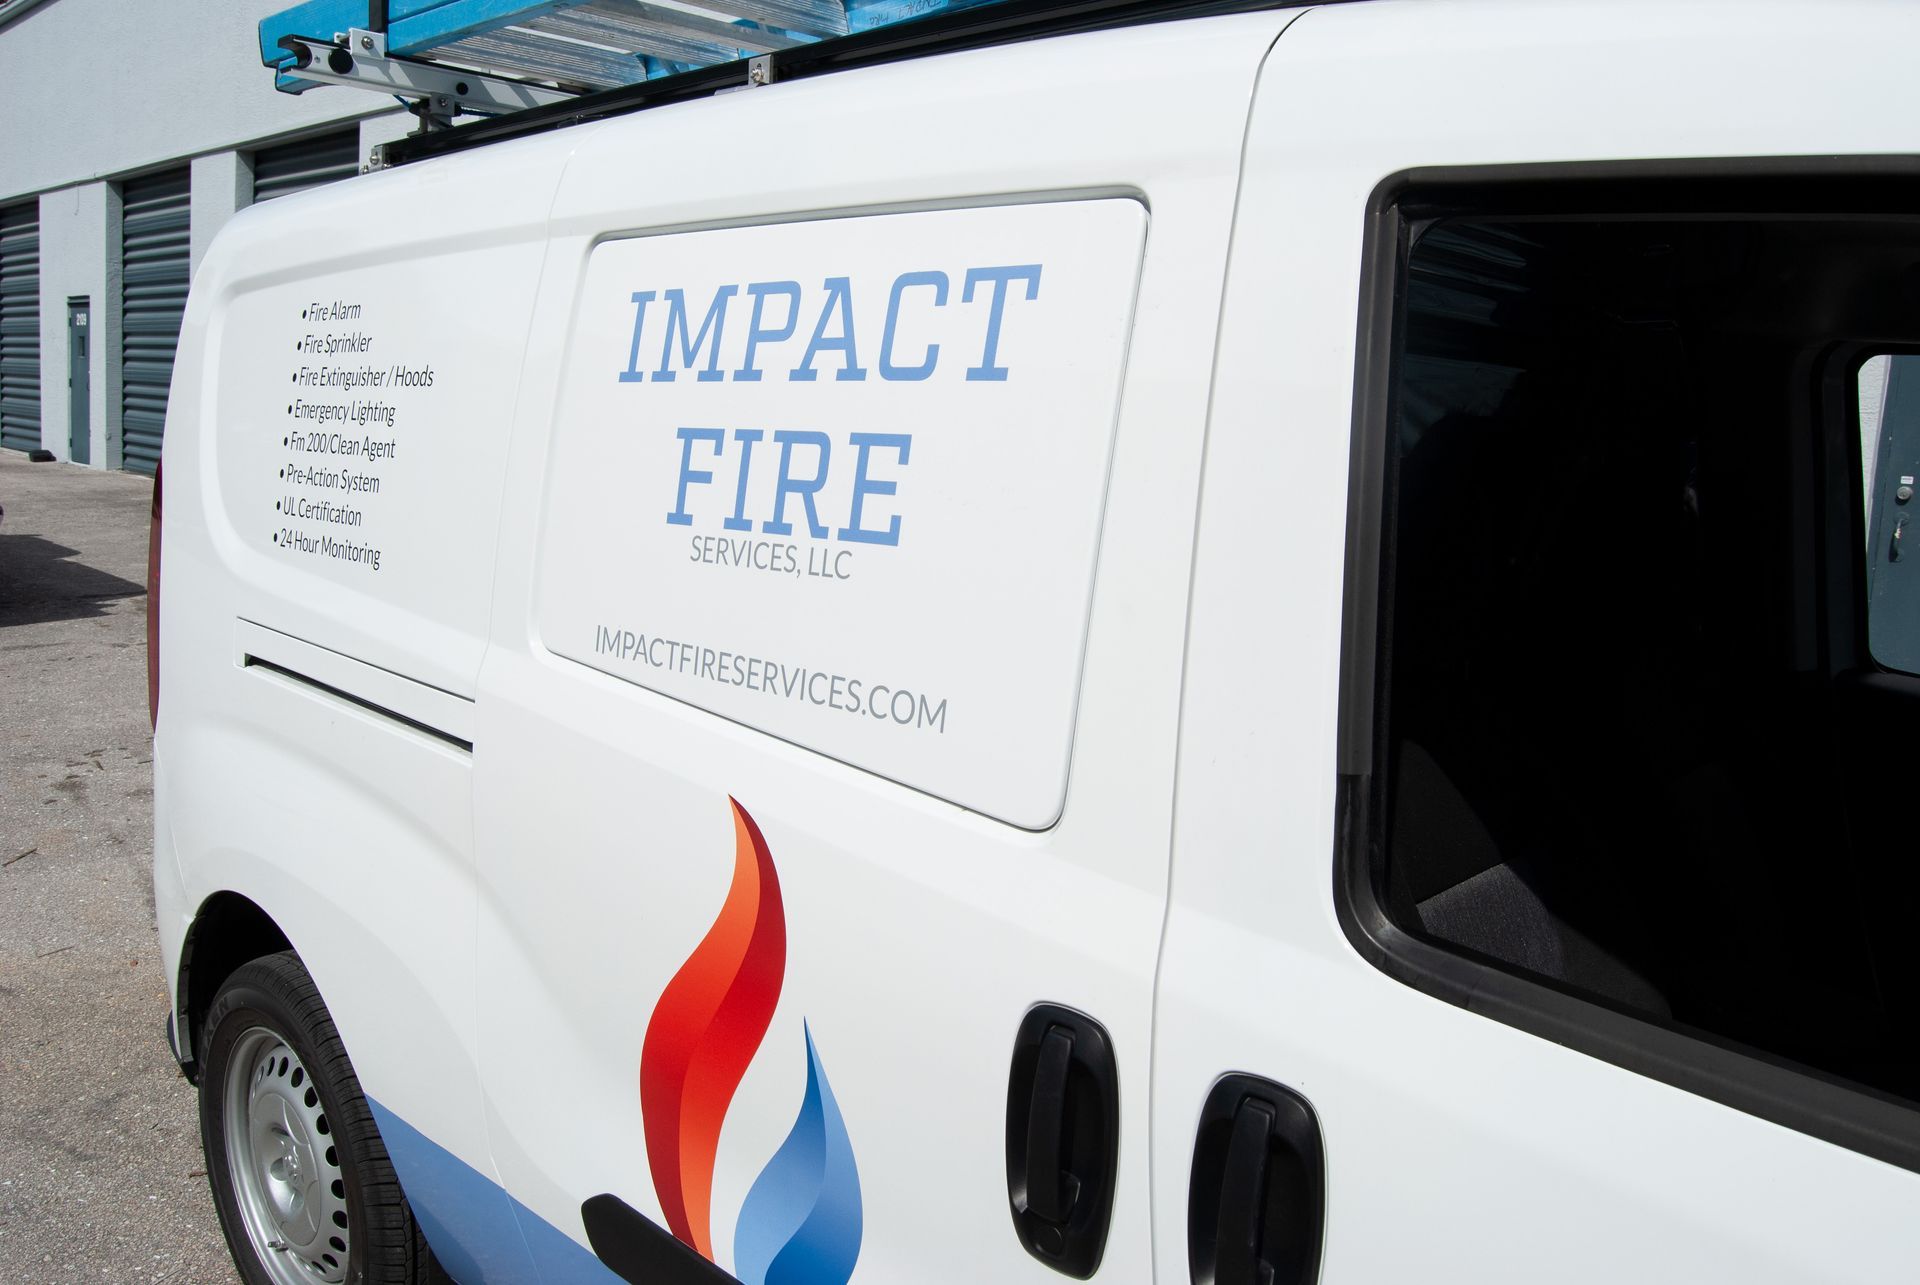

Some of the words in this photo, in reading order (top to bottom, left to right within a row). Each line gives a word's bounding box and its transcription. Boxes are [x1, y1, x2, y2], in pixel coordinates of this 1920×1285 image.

[308, 302, 329, 322] Fire
[329, 300, 362, 321] Alarm
[619, 264, 1042, 383] IMPACT
[303, 333, 324, 354] Fire
[324, 332, 373, 358] Sprinkler
[298, 366, 319, 387] Fire
[319, 365, 386, 392] Extinguisher
[394, 364, 435, 388] Hoods
[294, 398, 351, 425] Emergency
[351, 400, 397, 428] Lighting
[289, 431, 306, 452] Fm
[306, 432, 360, 457] 200/Clean
[360, 435, 397, 462] Agent
[286, 463, 339, 489] Pre-Action
[340, 468, 380, 496] System
[666, 427, 912, 547] FIRE
[283, 496, 297, 517] UL
[298, 497, 362, 528] Certification
[279, 528, 293, 549] 24
[293, 529, 320, 555] Hour
[320, 535, 382, 572] Monitoring
[689, 534, 801, 579] SERVICES,
[807, 546, 853, 580] LLC
[595, 624, 948, 734] IMPACTFIRESERVICES.COM
